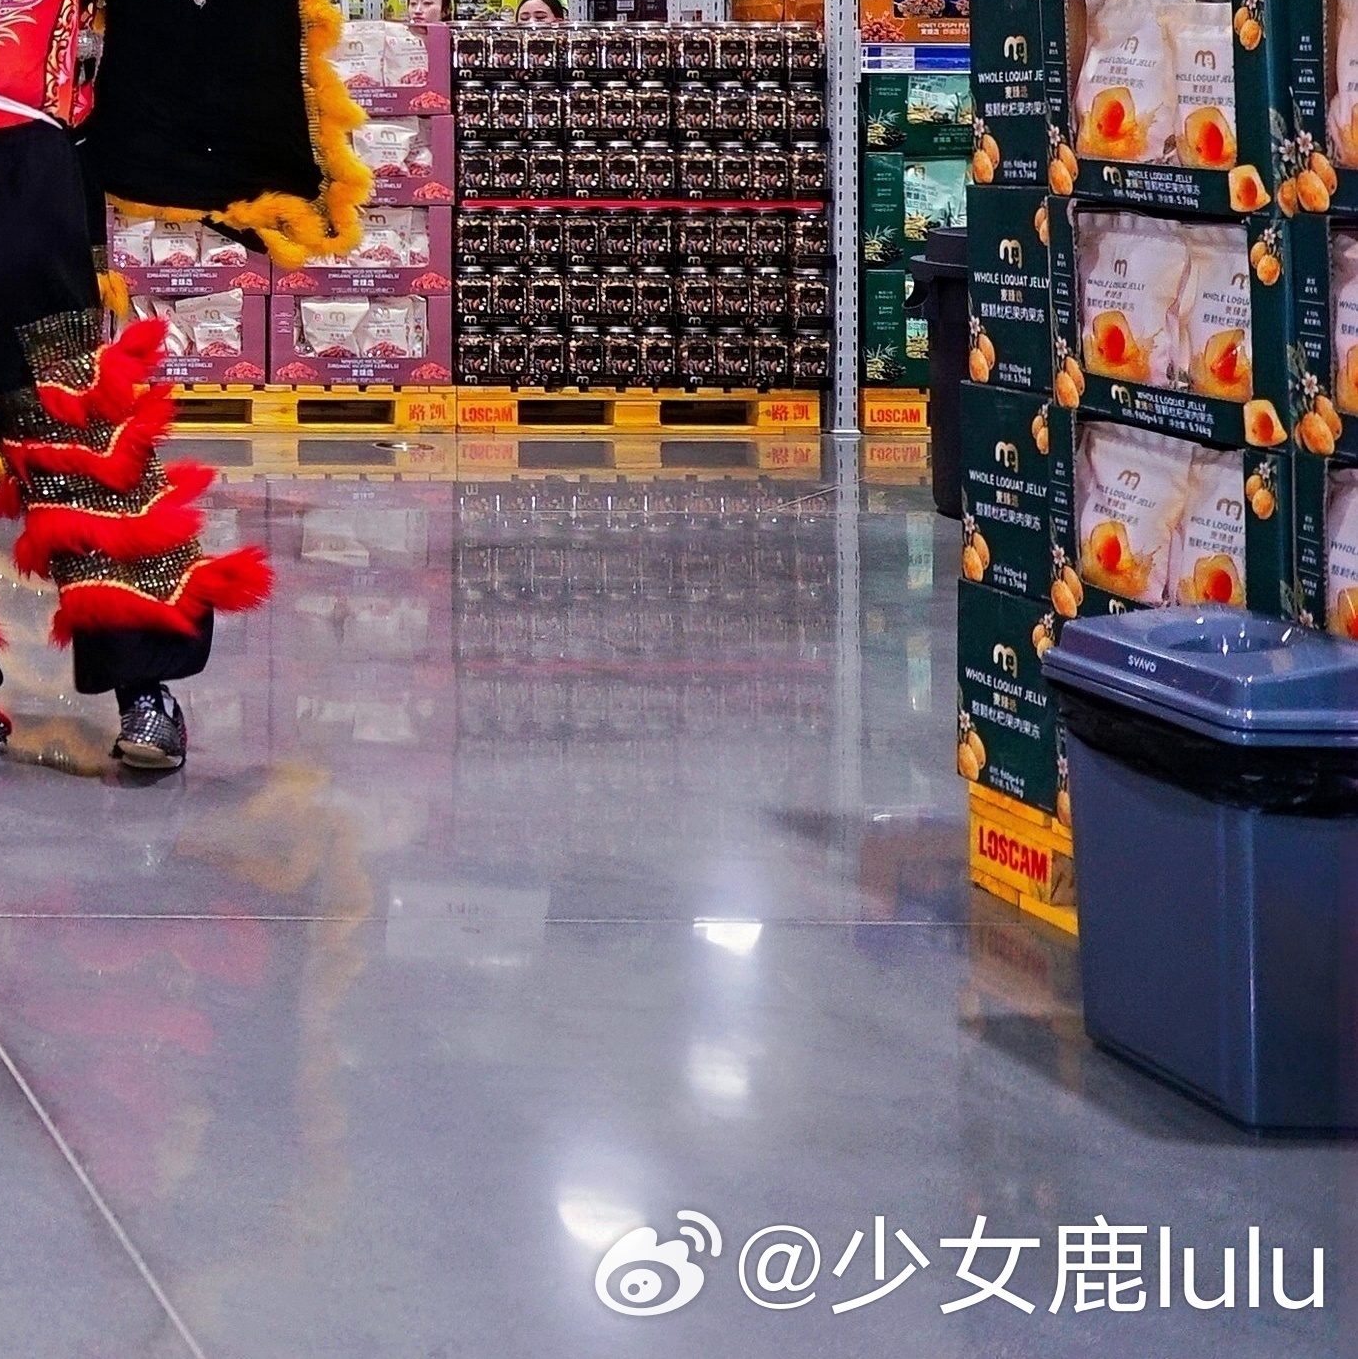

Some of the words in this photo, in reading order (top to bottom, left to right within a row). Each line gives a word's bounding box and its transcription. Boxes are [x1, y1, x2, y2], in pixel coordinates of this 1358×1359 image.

[978, 71, 1003, 83] WHOLE
[1005, 70, 1033, 83] LOQUAT
[974, 272, 999, 285] WHOLE
[1000, 273, 1028, 287] LOQUAT
[1029, 276, 1050, 289] JELLY
[409, 403, 447, 421] 路凯
[462, 407, 513, 422] LOSCAM
[771, 404, 810, 421] 路凯
[870, 408, 921, 423] LOSCAM
[969, 469, 994, 486] WHOLE
[995, 475, 1024, 492] LOQUAT
[1025, 481, 1047, 498] JELLY
[965, 666, 992, 687] WHOLE
[993, 675, 1023, 698] LOQUAT
[1024, 688, 1048, 707] JELLY
[978, 825, 1048, 884] LOSCAM
